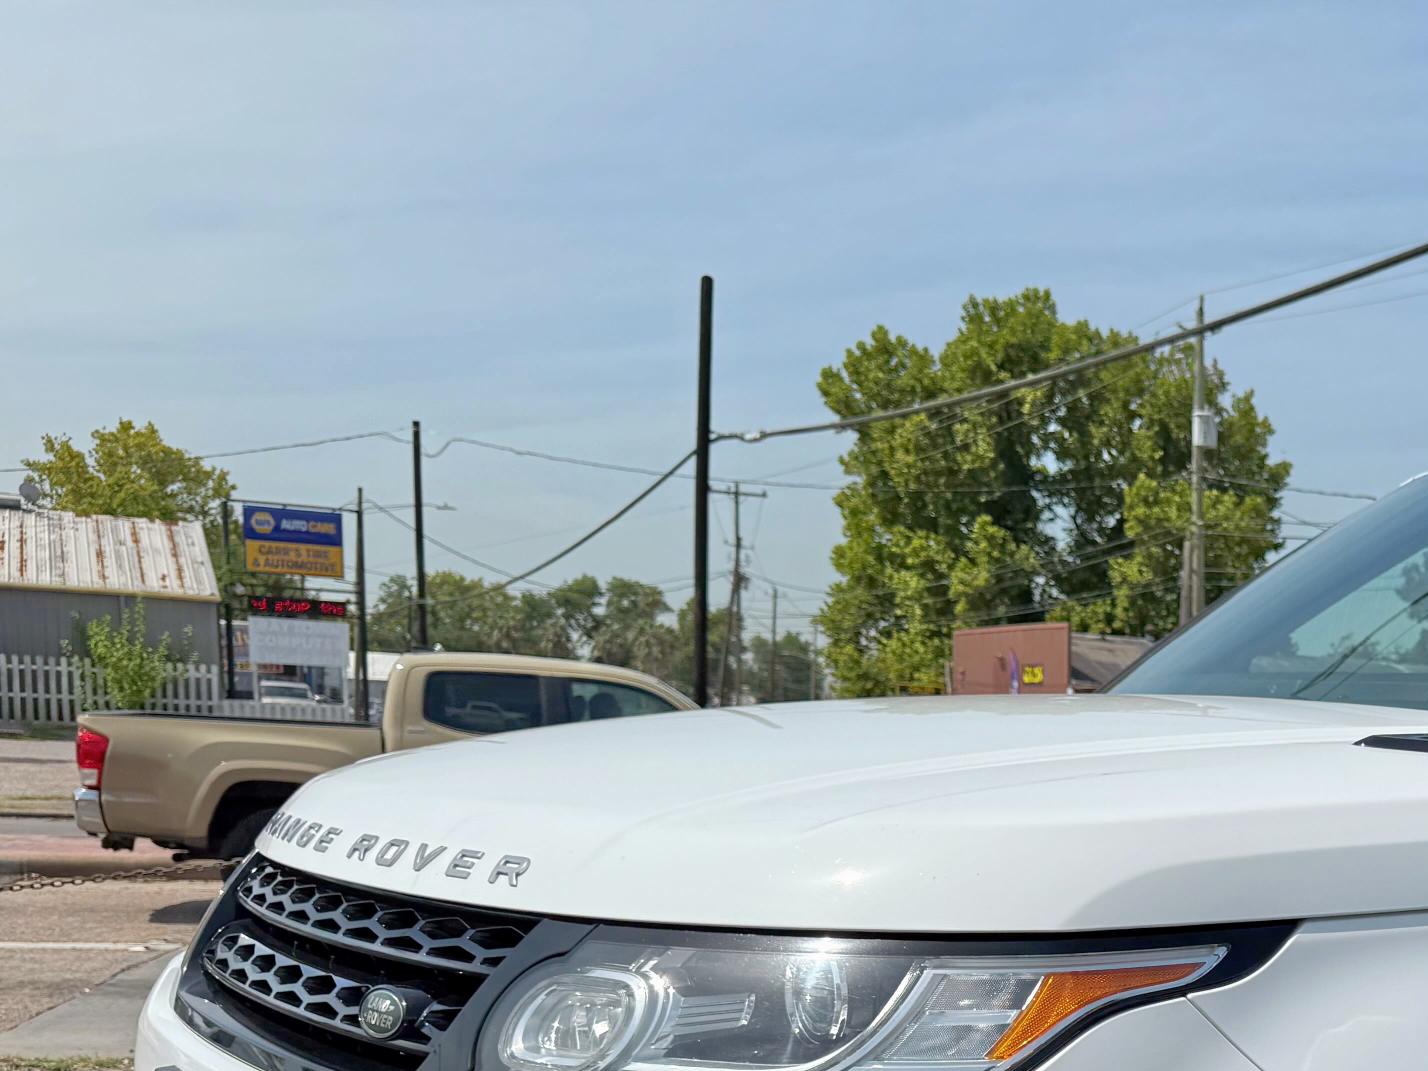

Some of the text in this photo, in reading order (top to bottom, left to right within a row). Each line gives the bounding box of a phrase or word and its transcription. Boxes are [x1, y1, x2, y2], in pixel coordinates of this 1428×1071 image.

[305, 546, 330, 560] TIRE
[263, 557, 337, 574] AUTOMOTIVE
[265, 811, 531, 887] RANGE ROVER
[367, 995, 391, 1013] LAND
[366, 1010, 393, 1029] ROVER
